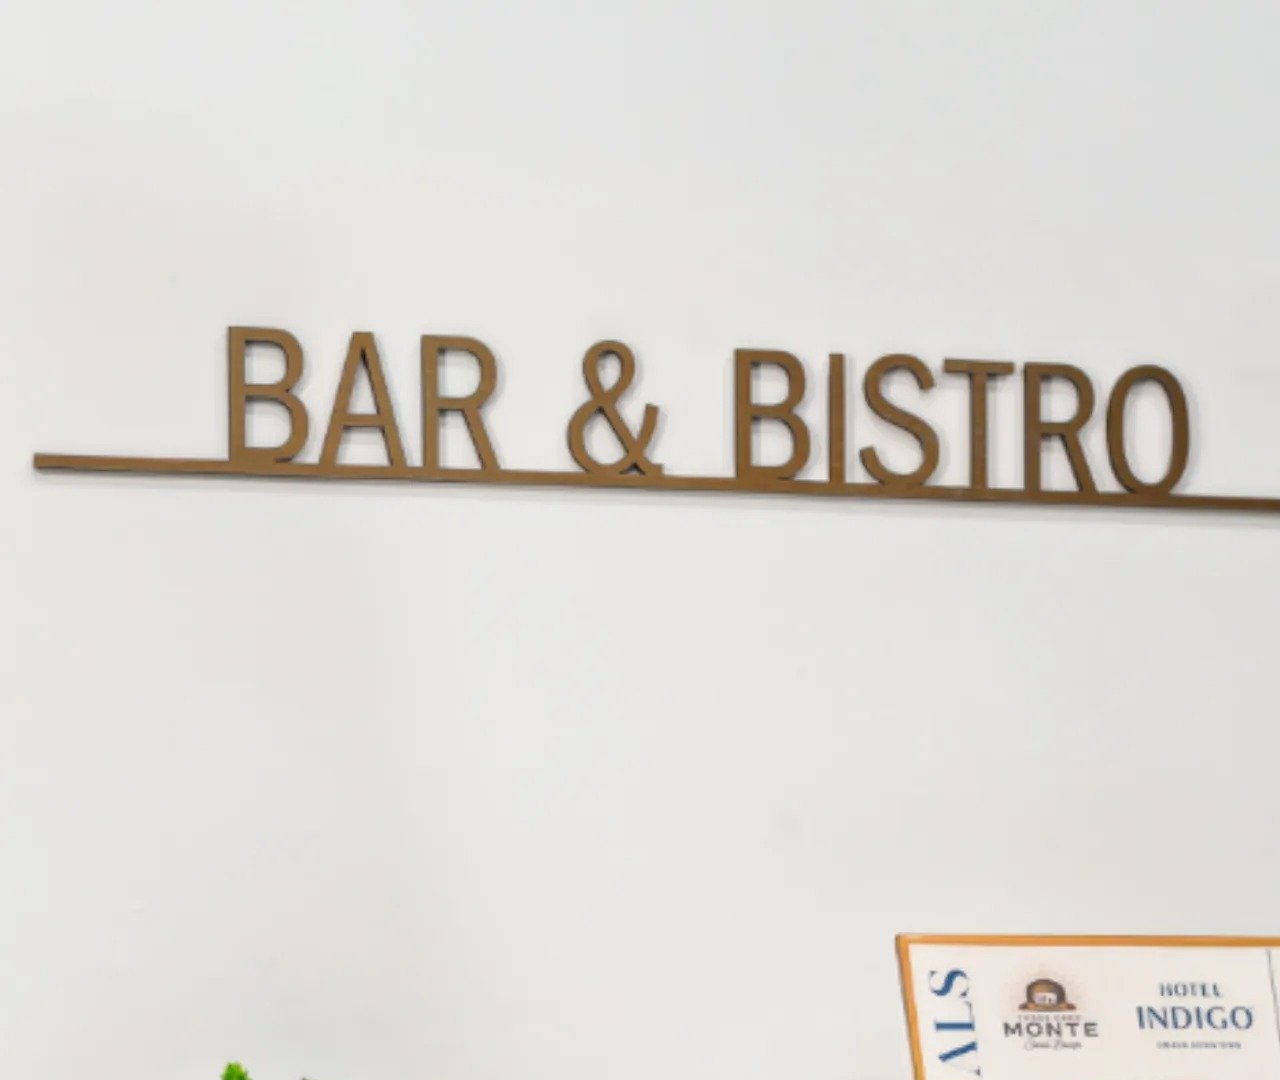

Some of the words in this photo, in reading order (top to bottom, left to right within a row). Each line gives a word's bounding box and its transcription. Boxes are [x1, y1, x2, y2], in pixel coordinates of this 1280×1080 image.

[228, 326, 501, 472] BAR
[567, 340, 663, 476] &
[734, 347, 1192, 497] BISTRO
[1159, 981, 1222, 998] HOTEL
[1135, 1005, 1253, 1031] INDIGO
[1004, 1022, 1099, 1038] MONTE
